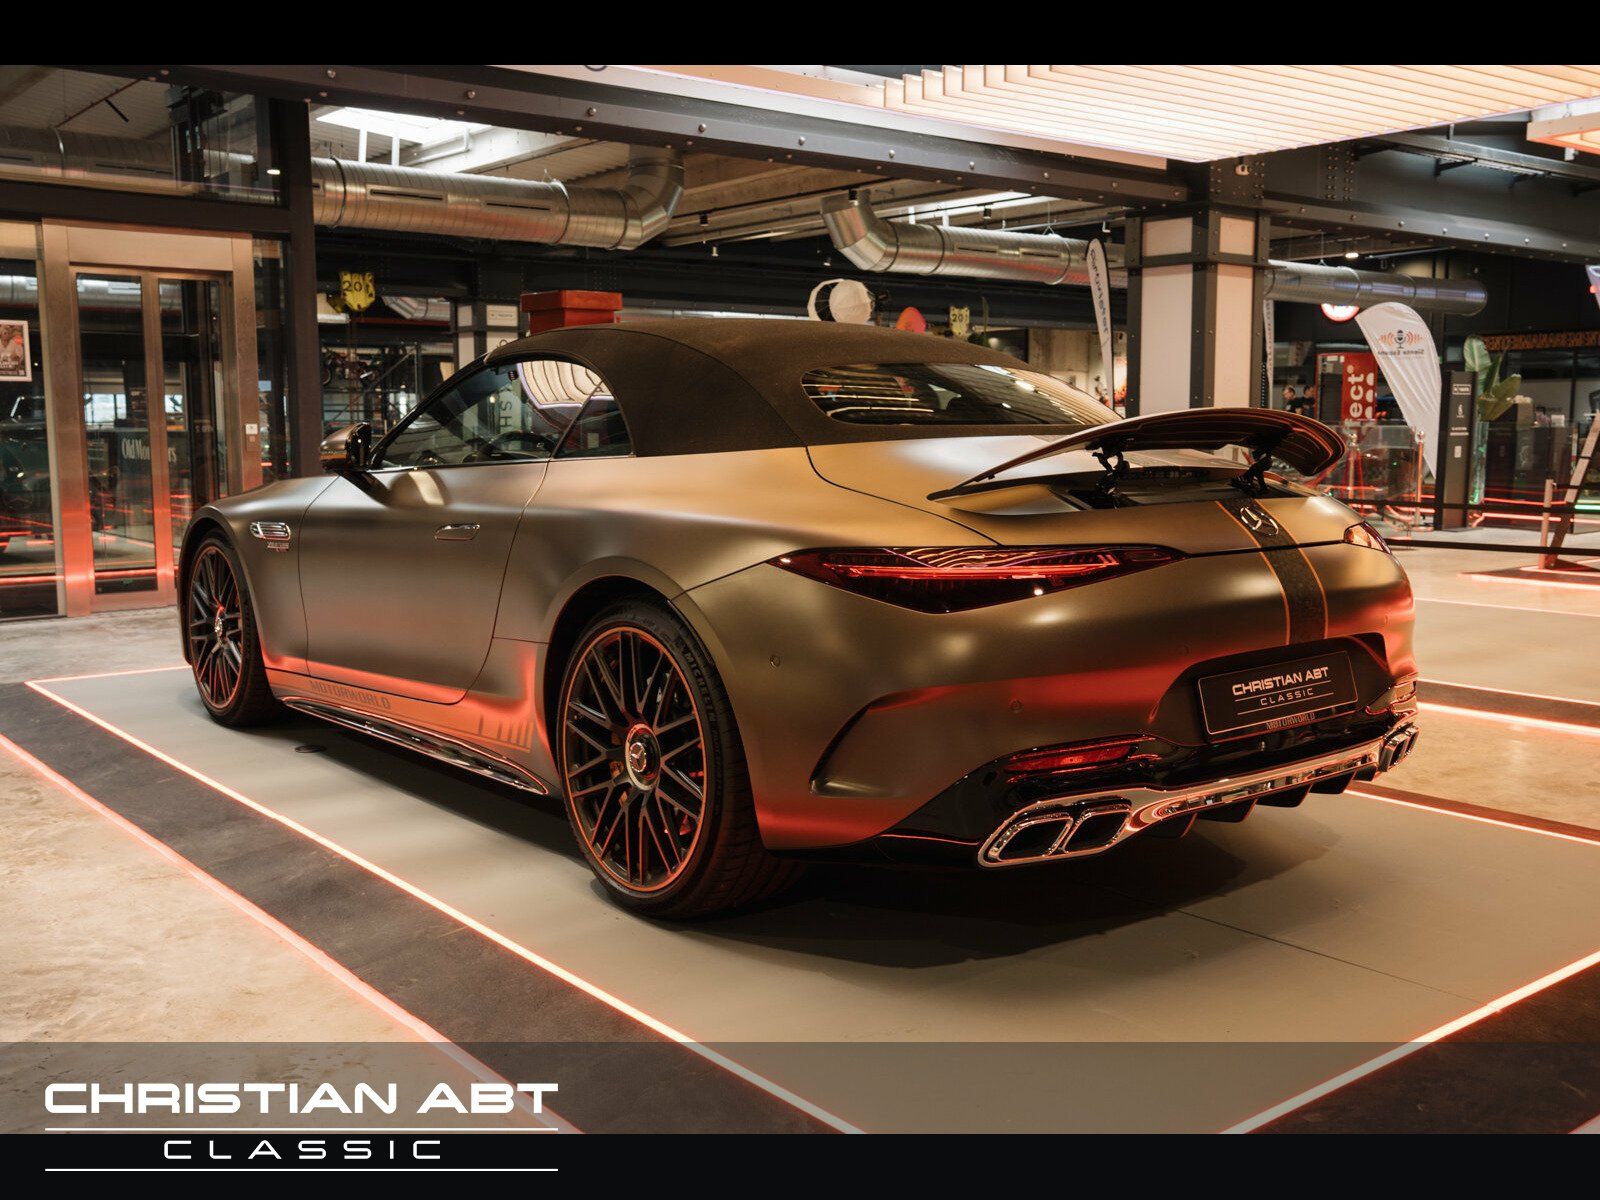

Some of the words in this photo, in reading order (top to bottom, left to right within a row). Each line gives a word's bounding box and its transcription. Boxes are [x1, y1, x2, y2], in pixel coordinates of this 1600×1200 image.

[309, 680, 391, 709] MOTORWORLD
[1231, 672, 1303, 696] CHRISTIAN
[1305, 666, 1329, 681] ABT
[1260, 687, 1315, 706] CLASSIC
